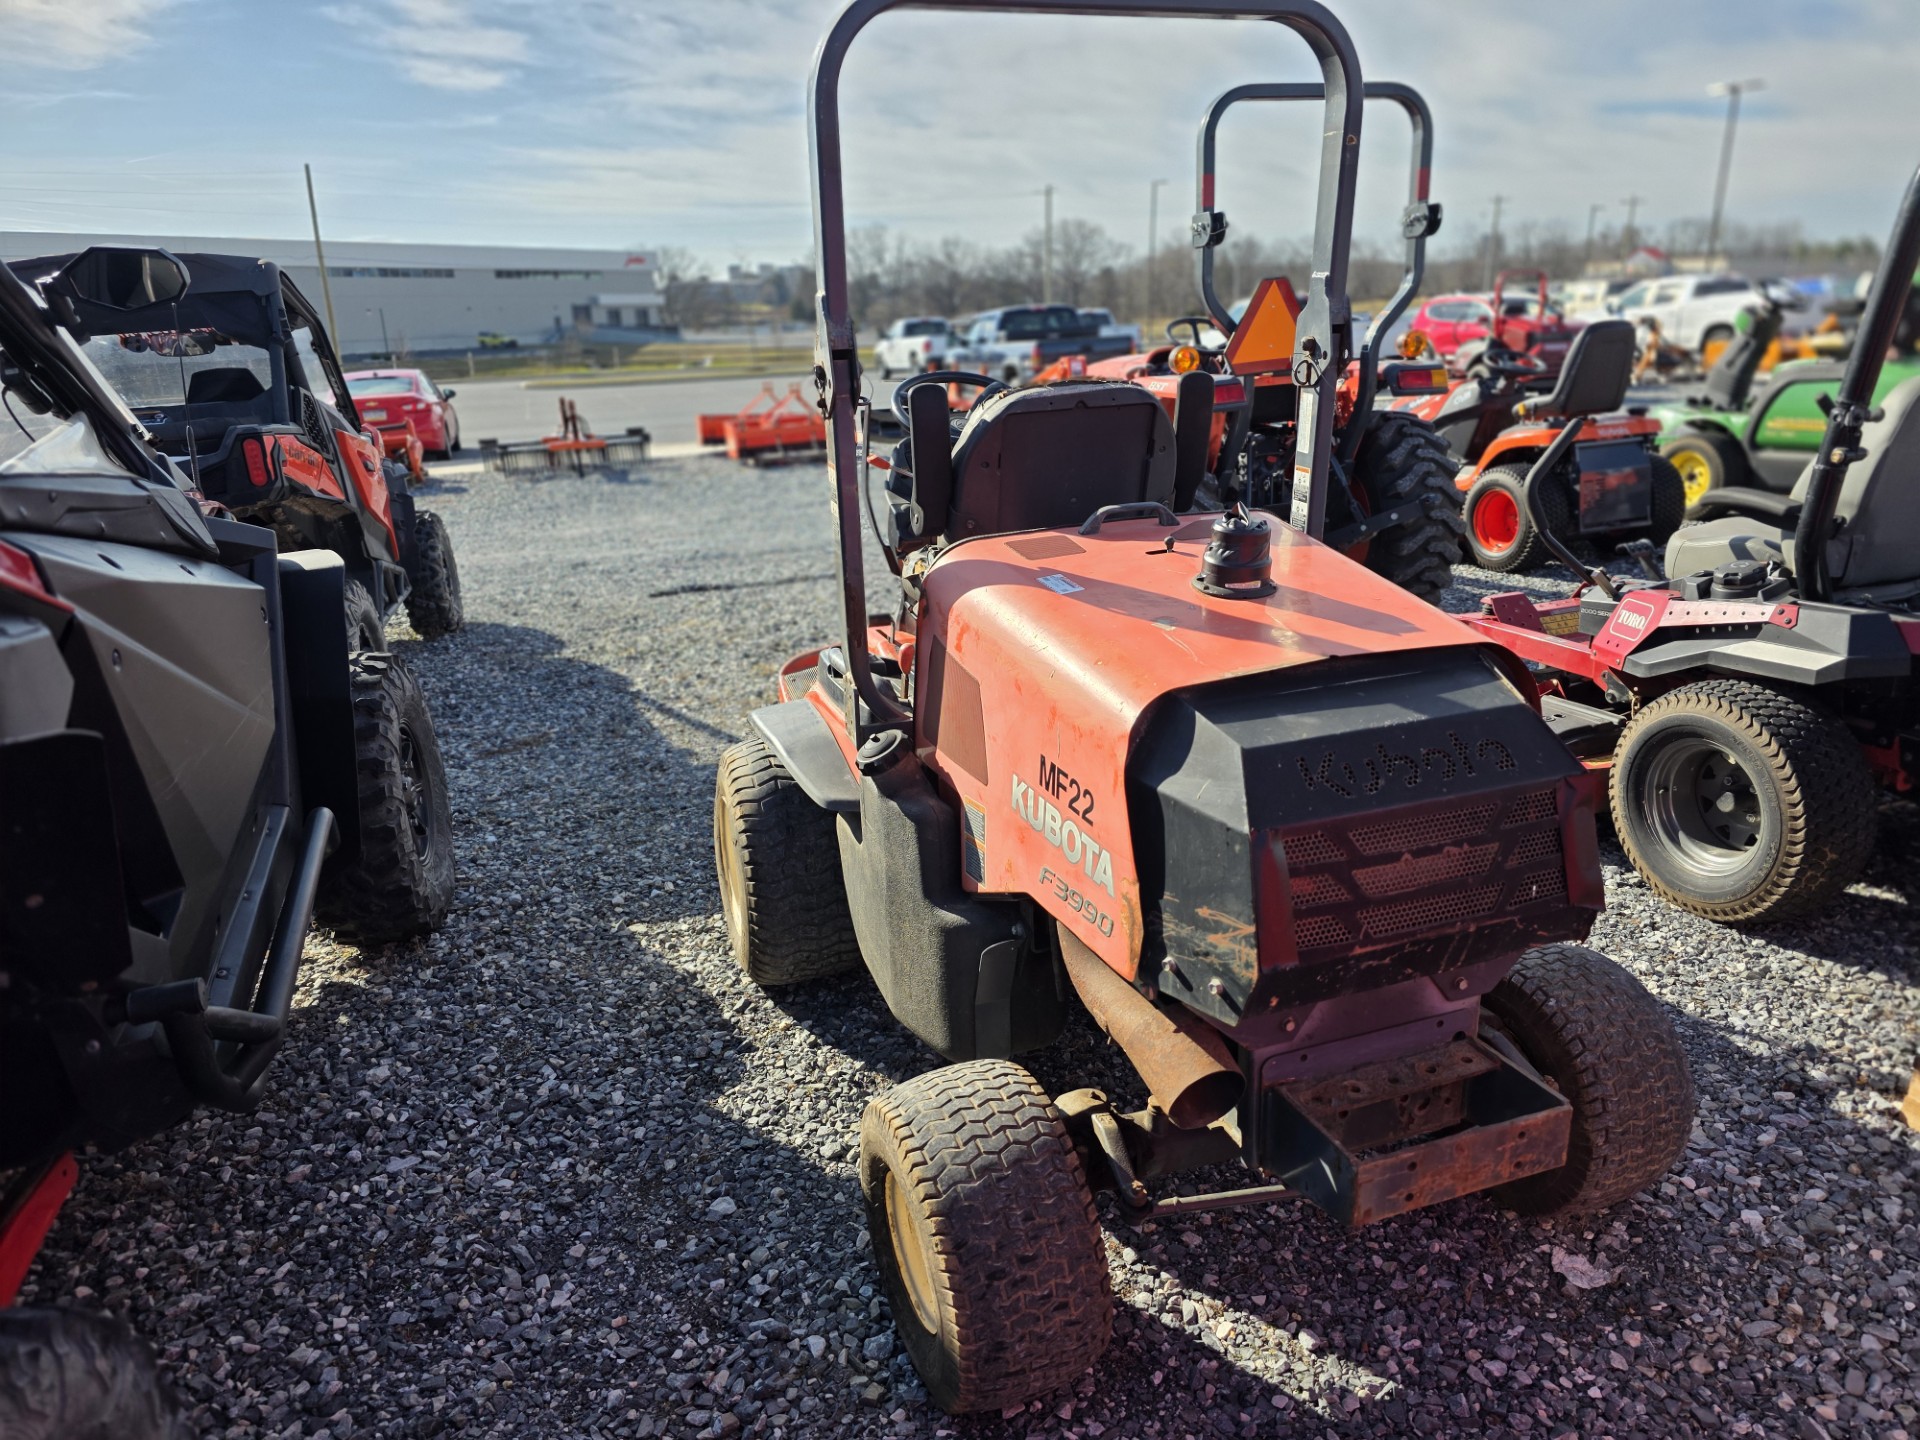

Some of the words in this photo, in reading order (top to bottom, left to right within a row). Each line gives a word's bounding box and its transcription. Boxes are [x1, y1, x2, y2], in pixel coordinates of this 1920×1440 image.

[1617, 609, 1646, 630] TORO
[1039, 753, 1095, 827] MF22
[1011, 773, 1115, 898] KUBOTA
[1039, 866, 1114, 938] F3990
